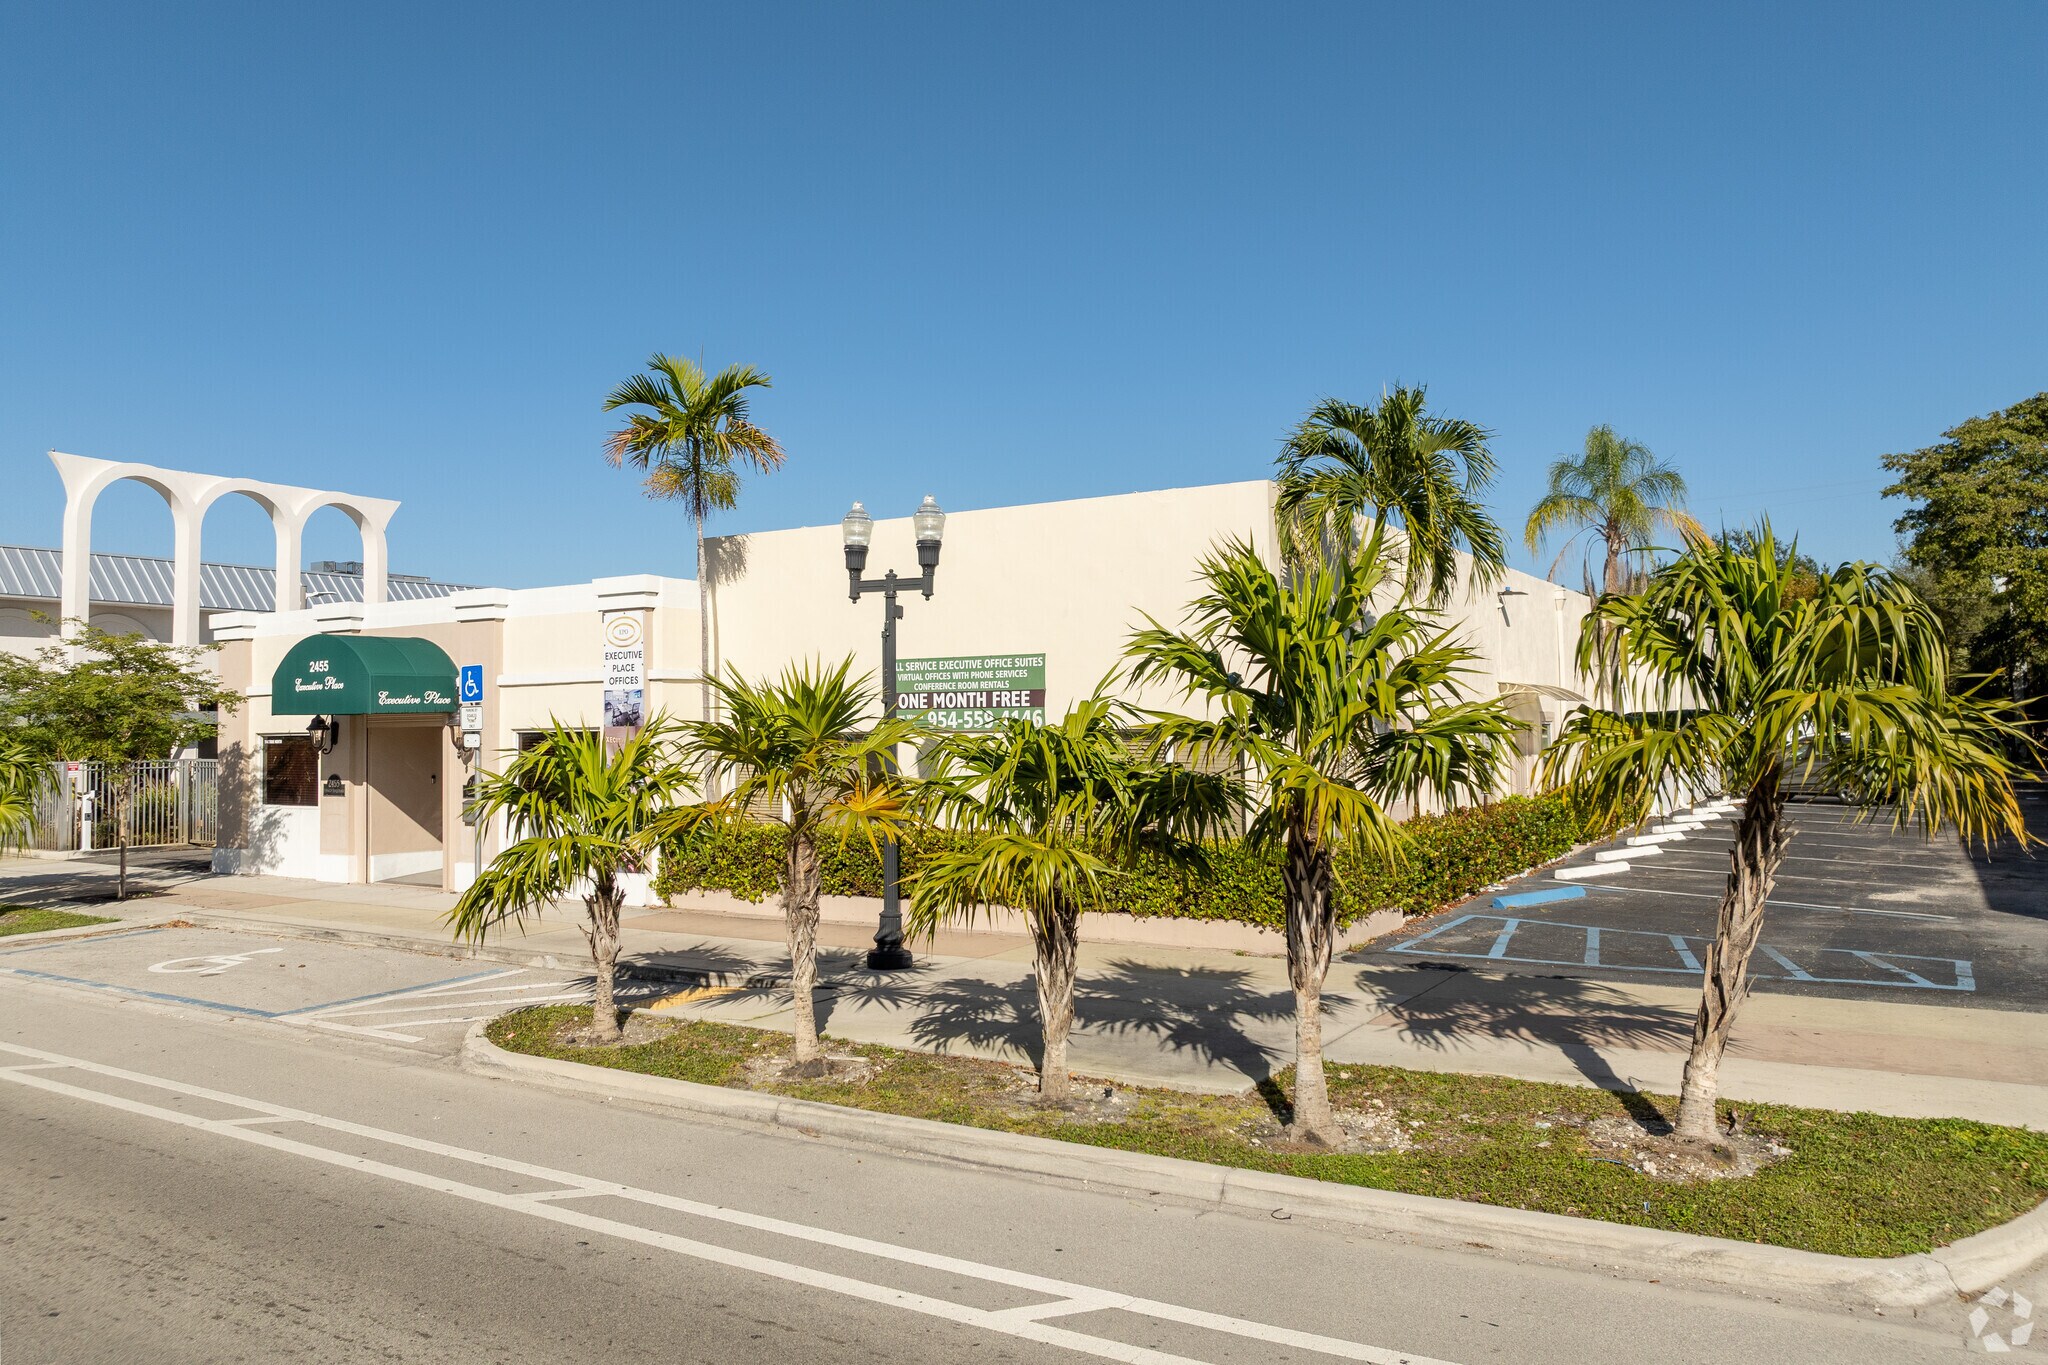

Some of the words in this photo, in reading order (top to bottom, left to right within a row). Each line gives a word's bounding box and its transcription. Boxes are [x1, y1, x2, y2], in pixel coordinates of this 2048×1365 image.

[605, 651, 642, 660] EXECUTIVE
[309, 660, 329, 672] 2455
[612, 663, 635, 672] PLACE
[905, 661, 937, 671] SERVICE
[939, 659, 982, 670] EXECUTIVE
[984, 658, 1013, 668] OFFICE
[1014, 657, 1043, 667] SUITES
[608, 676, 639, 685] OFFICES
[897, 673, 923, 681] VIRTUAL
[924, 672, 951, 680] OFFICES
[952, 671, 969, 680] WITH
[970, 670, 994, 679] PHONE
[995, 669, 1028, 678] SERVICES
[295, 678, 323, 692] Executive
[324, 676, 344, 690] Place
[913, 682, 956, 691] CONFERENCE
[957, 681, 979, 690] ROOM
[980, 680, 1010, 689] RENTALS
[378, 690, 421, 706] Executive
[423, 690, 451, 705] Place
[898, 693, 928, 709] ONE
[932, 691, 987, 708] MONTH
[992, 690, 1031, 707] FREE
